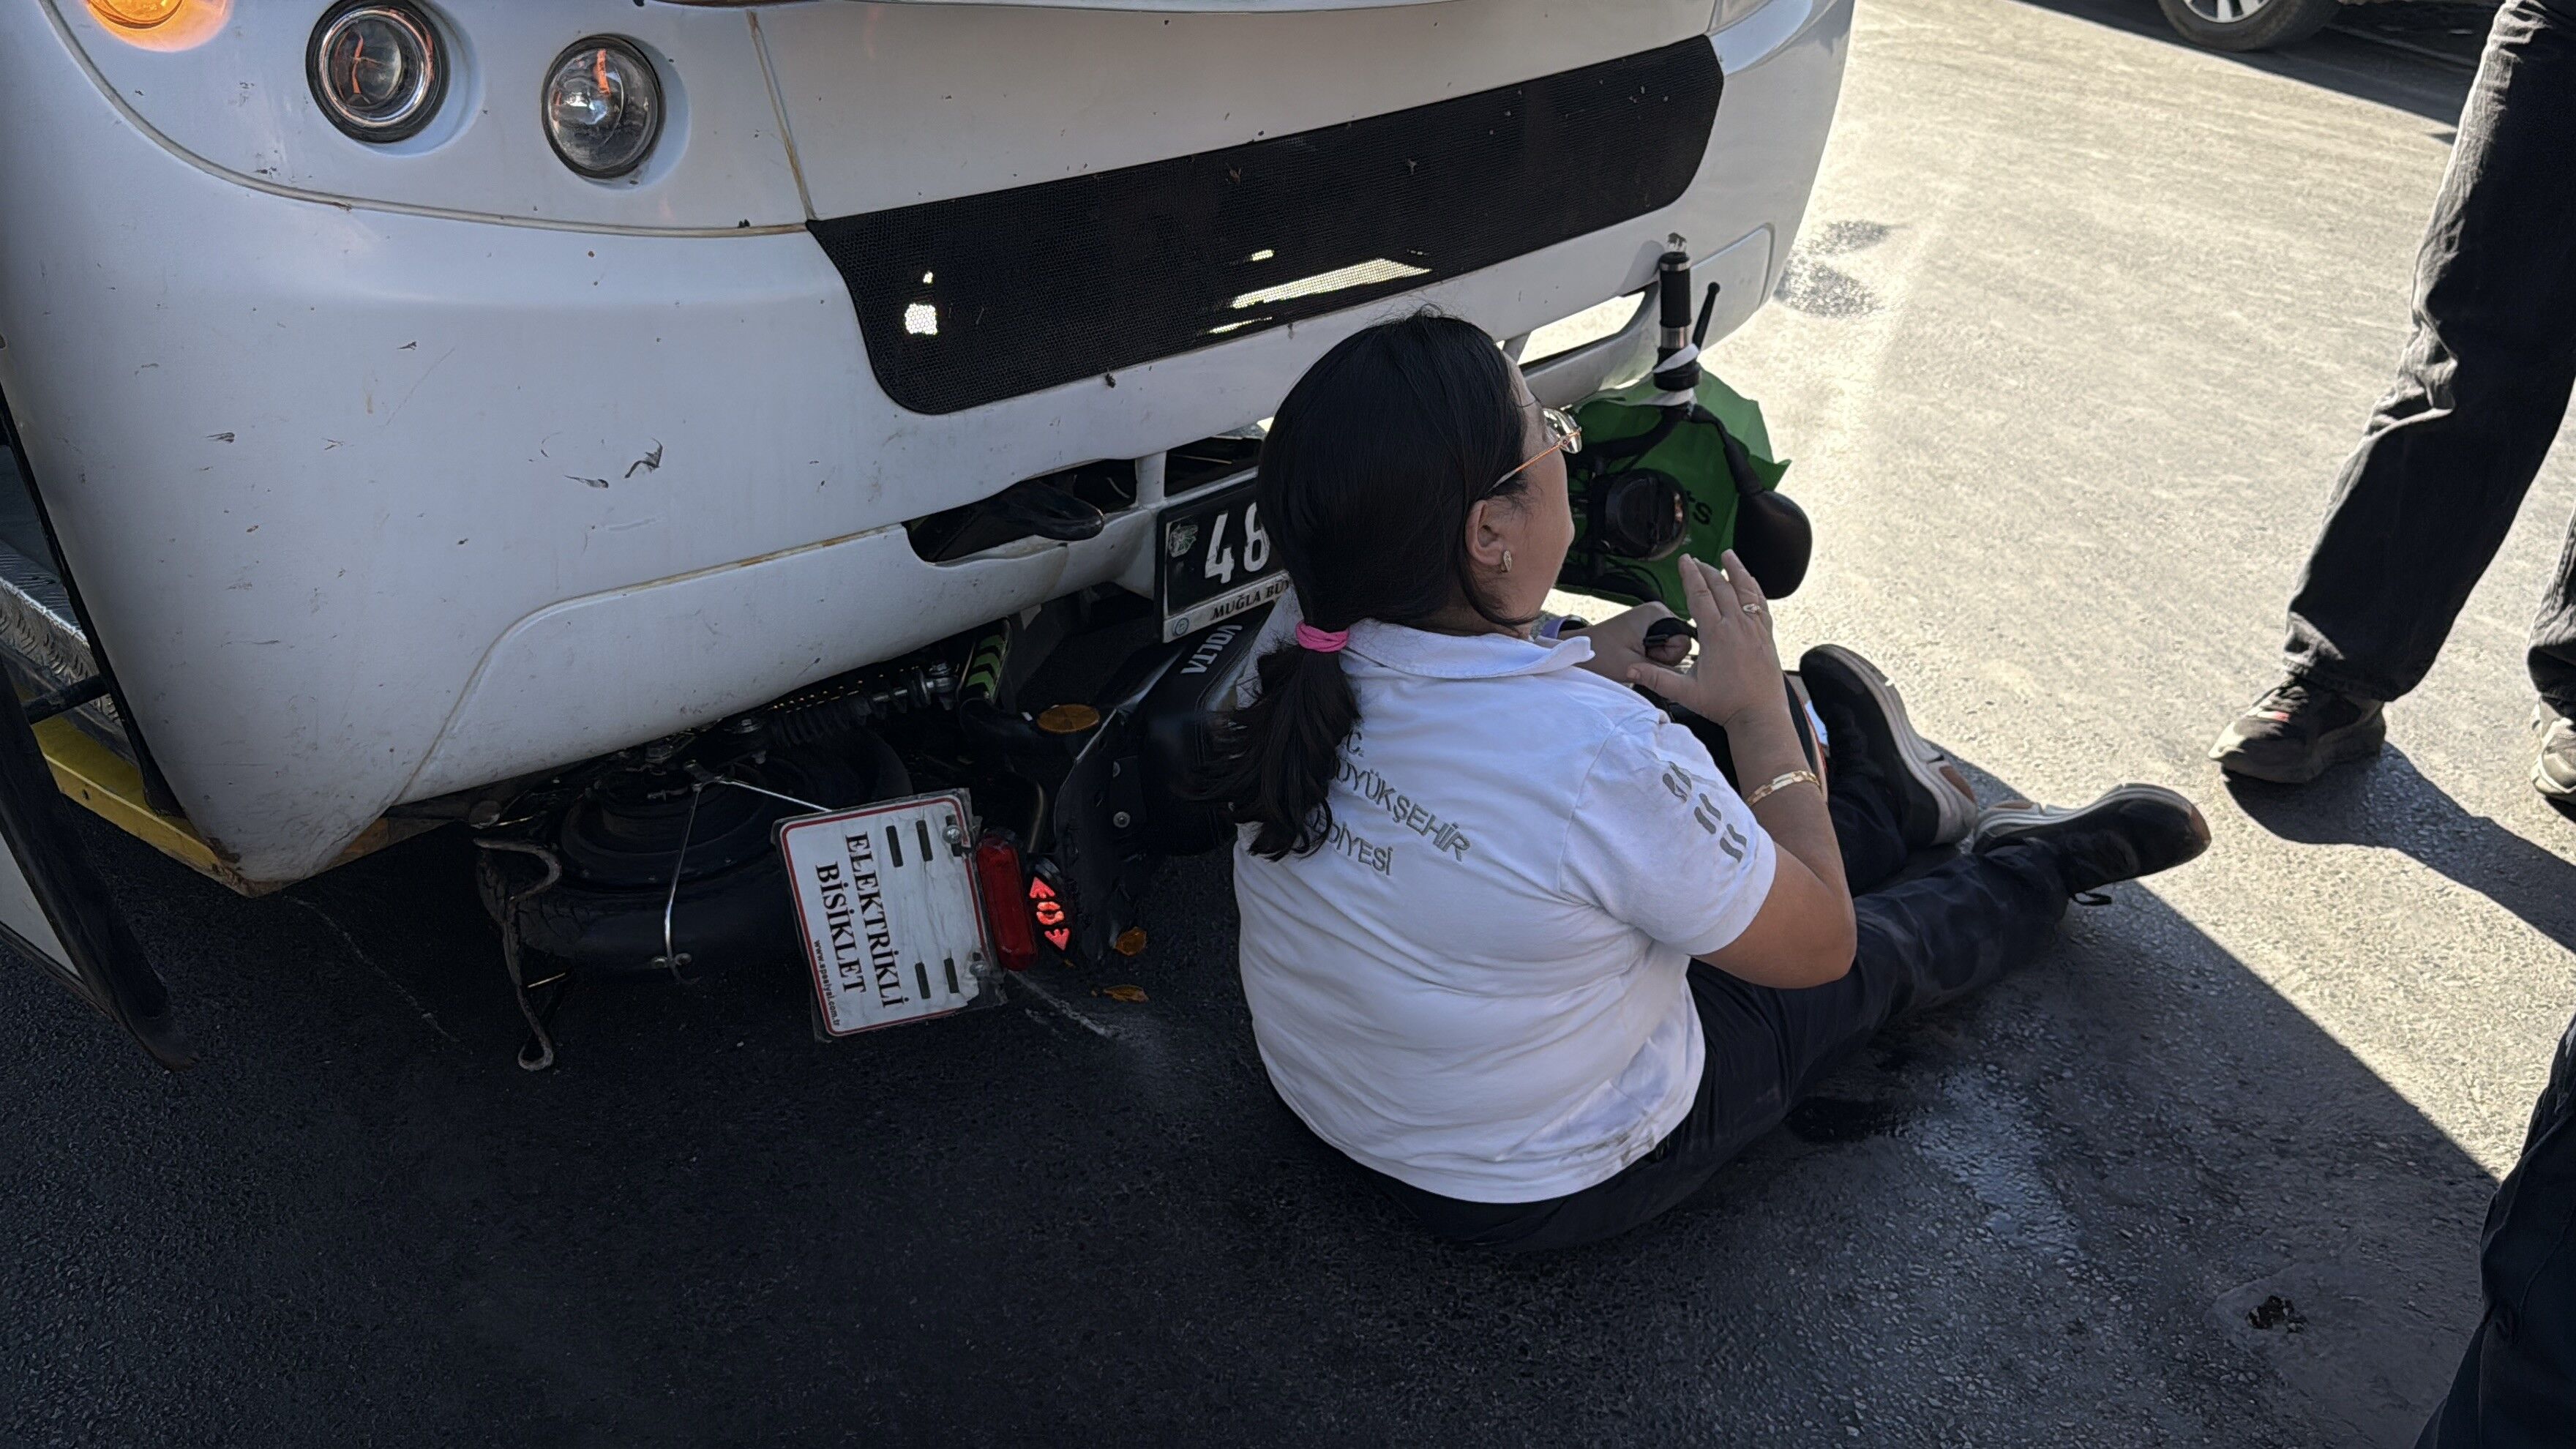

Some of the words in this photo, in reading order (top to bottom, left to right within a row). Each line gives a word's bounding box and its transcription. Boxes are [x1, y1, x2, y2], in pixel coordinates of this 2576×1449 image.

[1180, 625, 1243, 674] VOLTA
[1211, 591, 1261, 621] MUĞLA
[1336, 757, 1470, 862] ÜYÜKŞEHİR
[816, 861, 866, 994] BİSİKLET
[845, 831, 910, 1008] ELEKTRİKLİ
